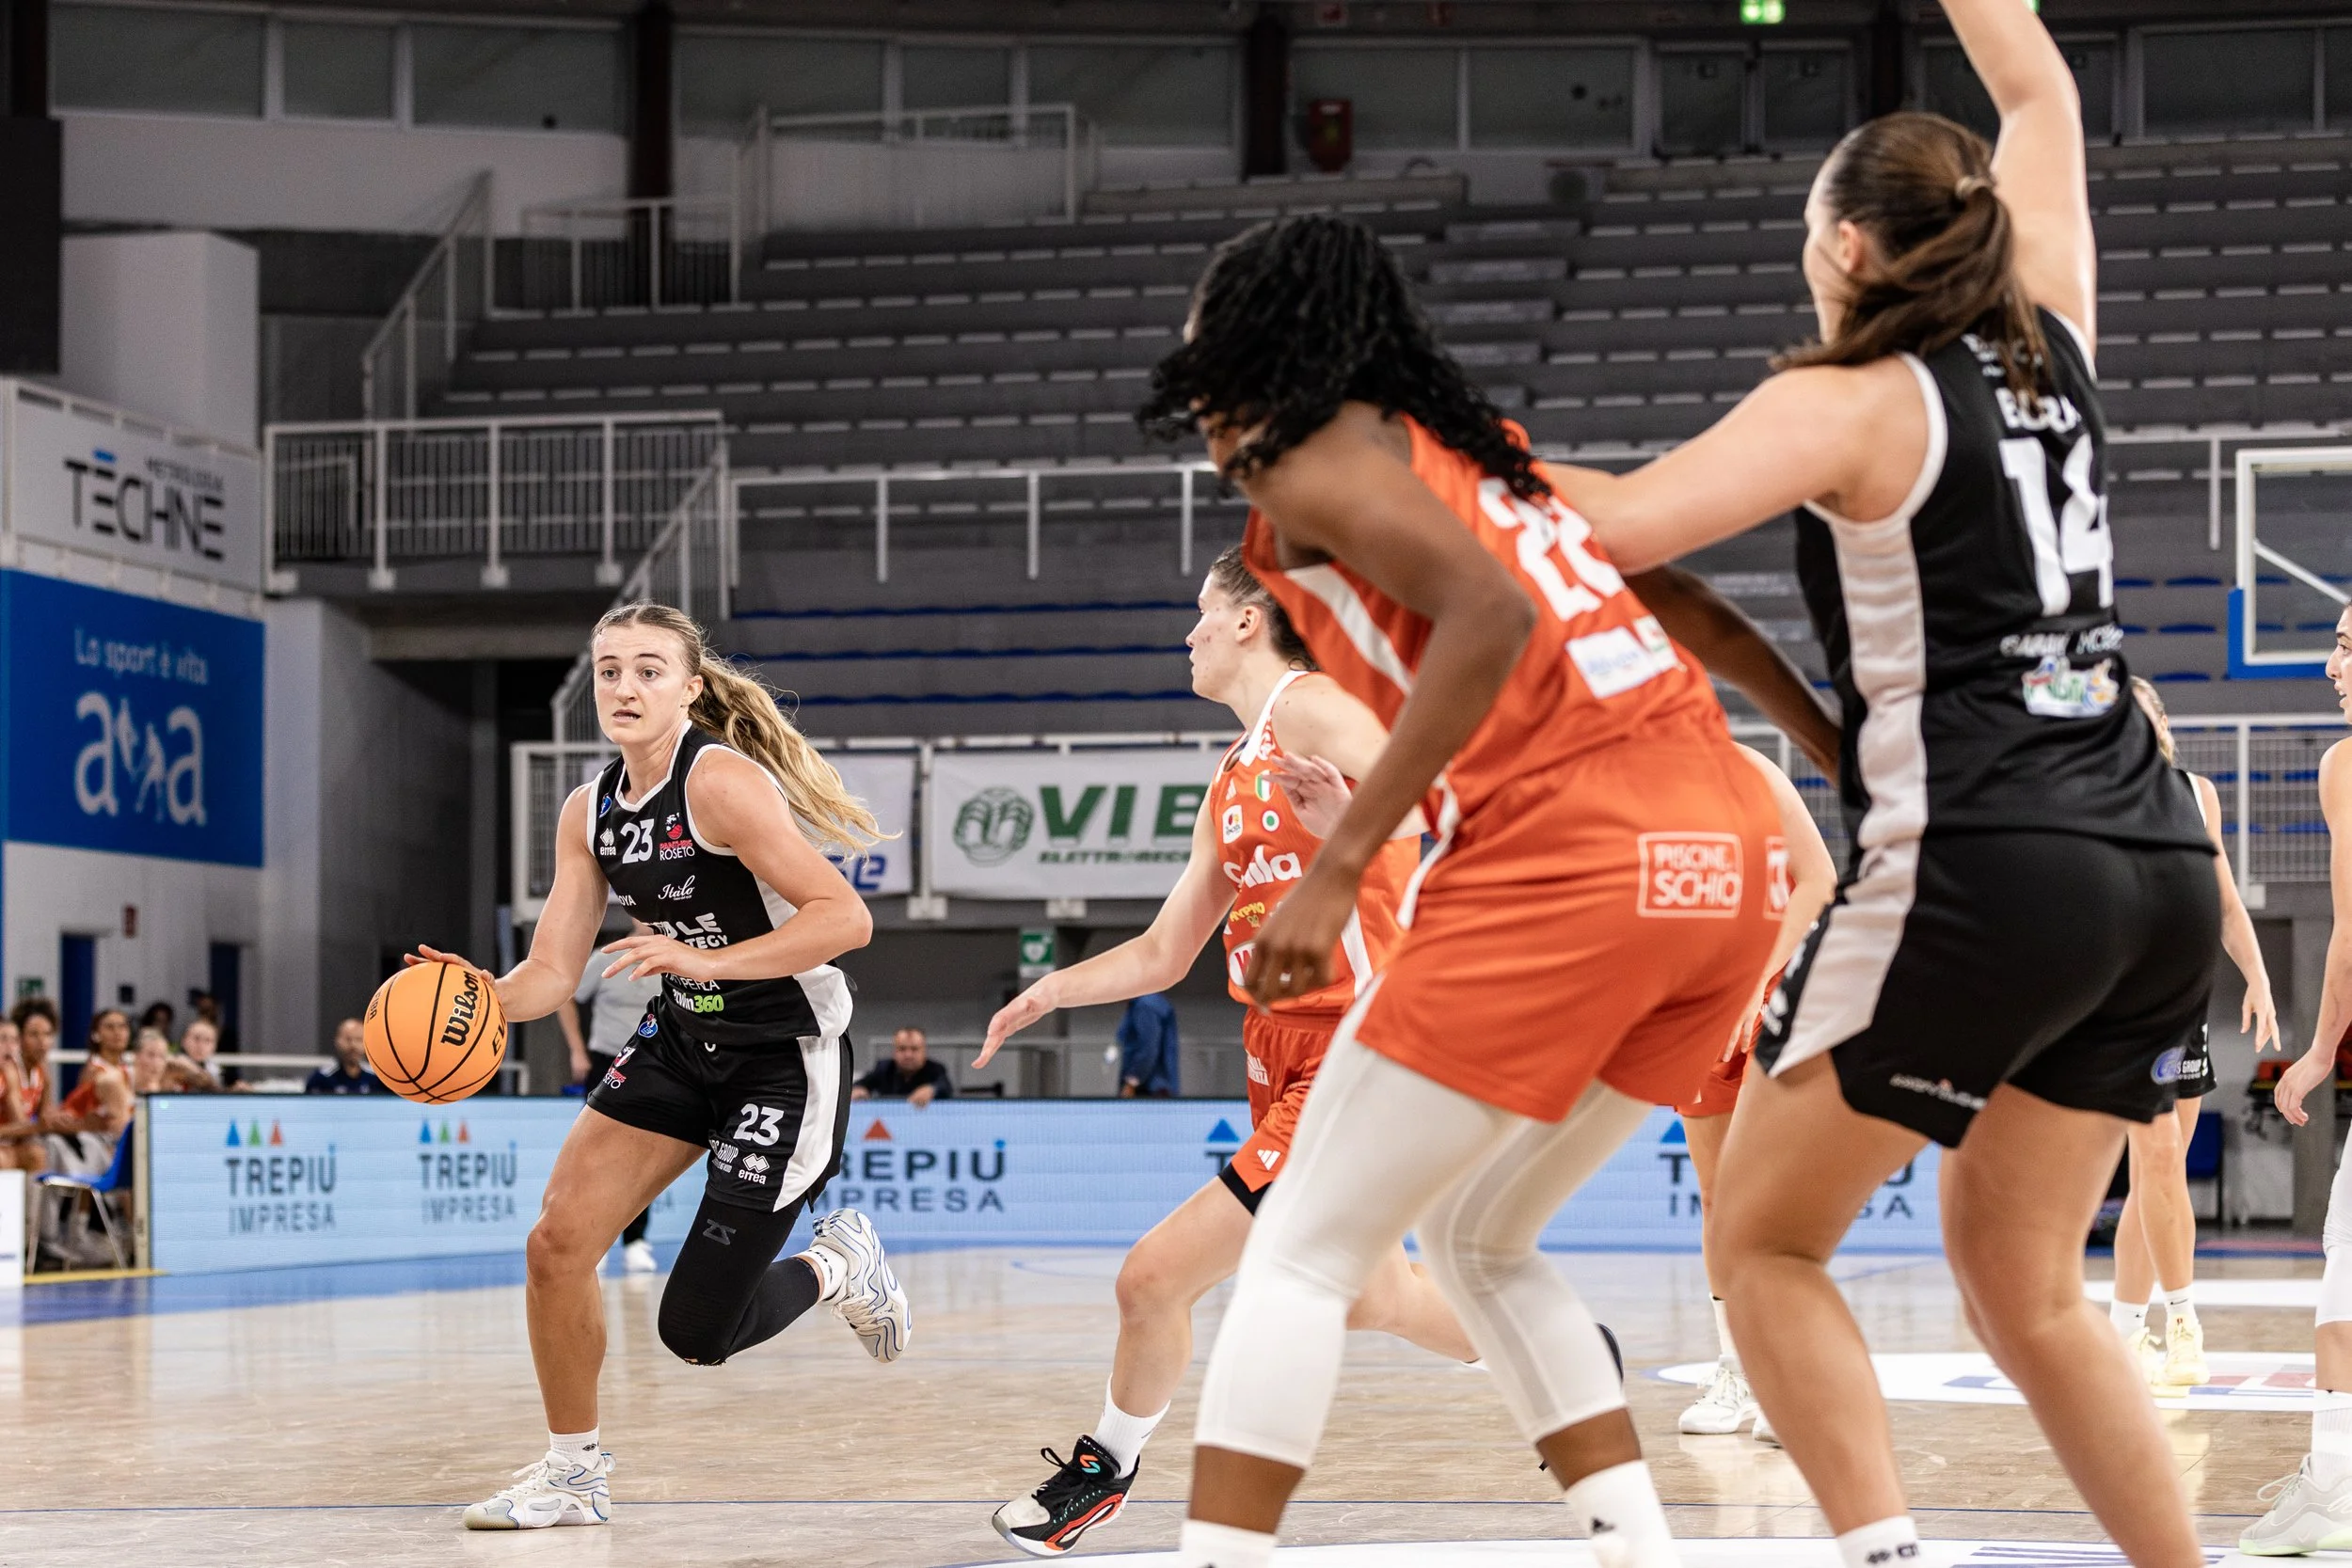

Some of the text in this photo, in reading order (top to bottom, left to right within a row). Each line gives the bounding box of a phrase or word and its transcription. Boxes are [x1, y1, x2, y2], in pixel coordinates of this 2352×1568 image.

[1999, 433, 2113, 617] 14
[620, 817, 655, 864] 23
[660, 846, 695, 862] ROSETO
[658, 875, 696, 900] Italo
[1652, 870, 1741, 908] SCHIO
[440, 970, 480, 1047] Wilson
[733, 1103, 785, 1147] 23
[229, 1202, 335, 1234] IMPRESA
[422, 1196, 516, 1224] IMPRESA
